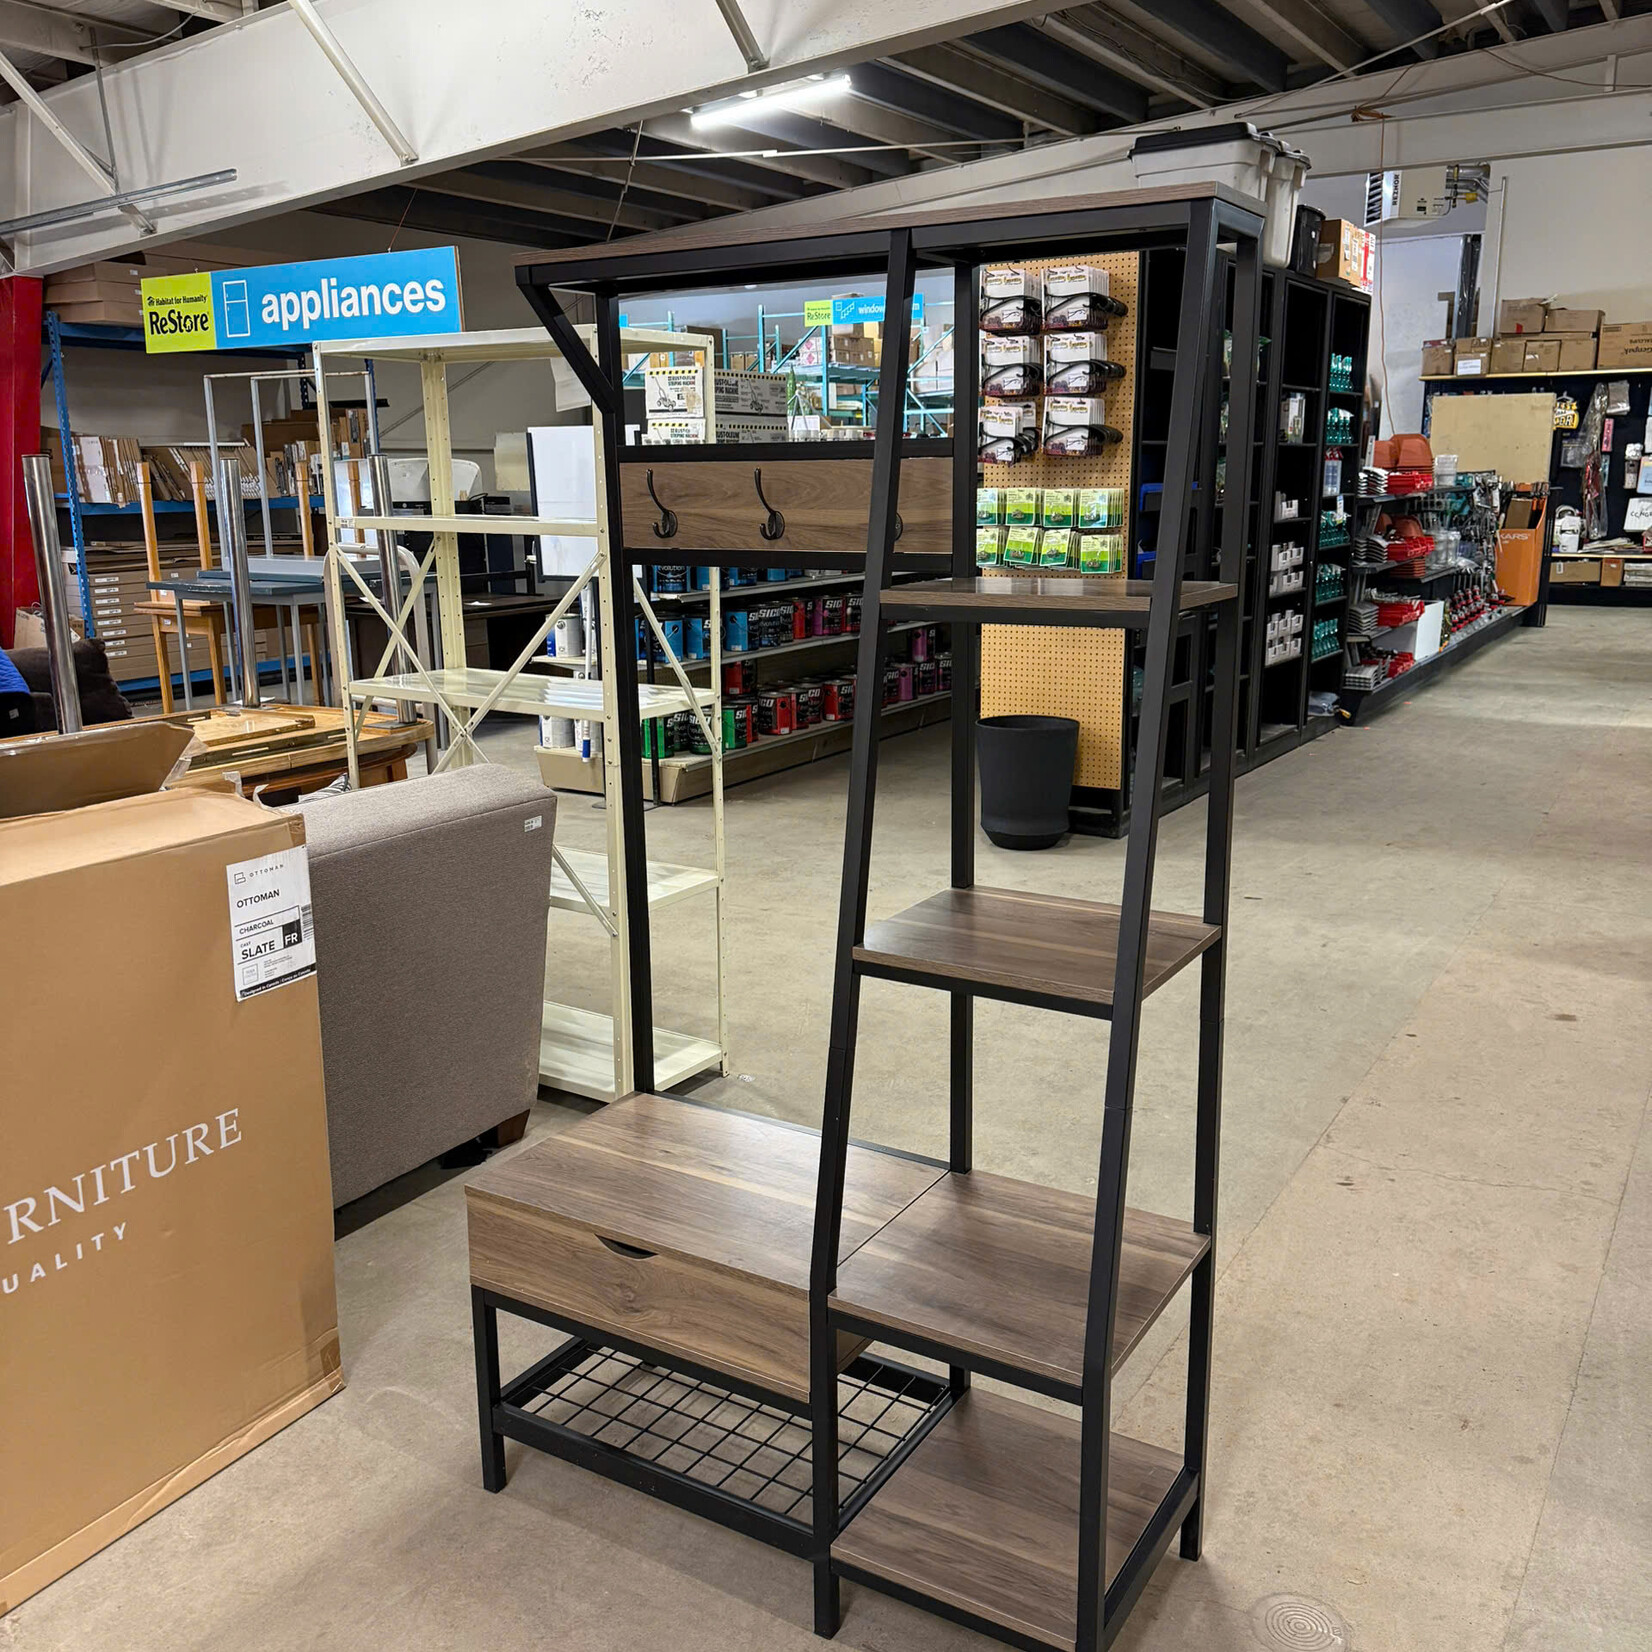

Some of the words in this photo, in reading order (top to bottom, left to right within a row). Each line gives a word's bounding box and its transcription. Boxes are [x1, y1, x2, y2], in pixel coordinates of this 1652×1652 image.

[1392, 174, 1400, 206] REZNOR
[155, 297, 174, 306] Habitat
[182, 295, 207, 304] Humanity
[261, 276, 447, 331] appliances
[148, 308, 209, 336] ReStore
[806, 311, 831, 321] ReStore
[236, 888, 280, 909] OTTOMAN
[239, 919, 274, 935] CHARCOAL
[241, 939, 276, 960] SLATE
[284, 933, 298, 946] FR
[3, 1108, 242, 1245] RNITURE
[2, 1222, 126, 1294] UALITY
